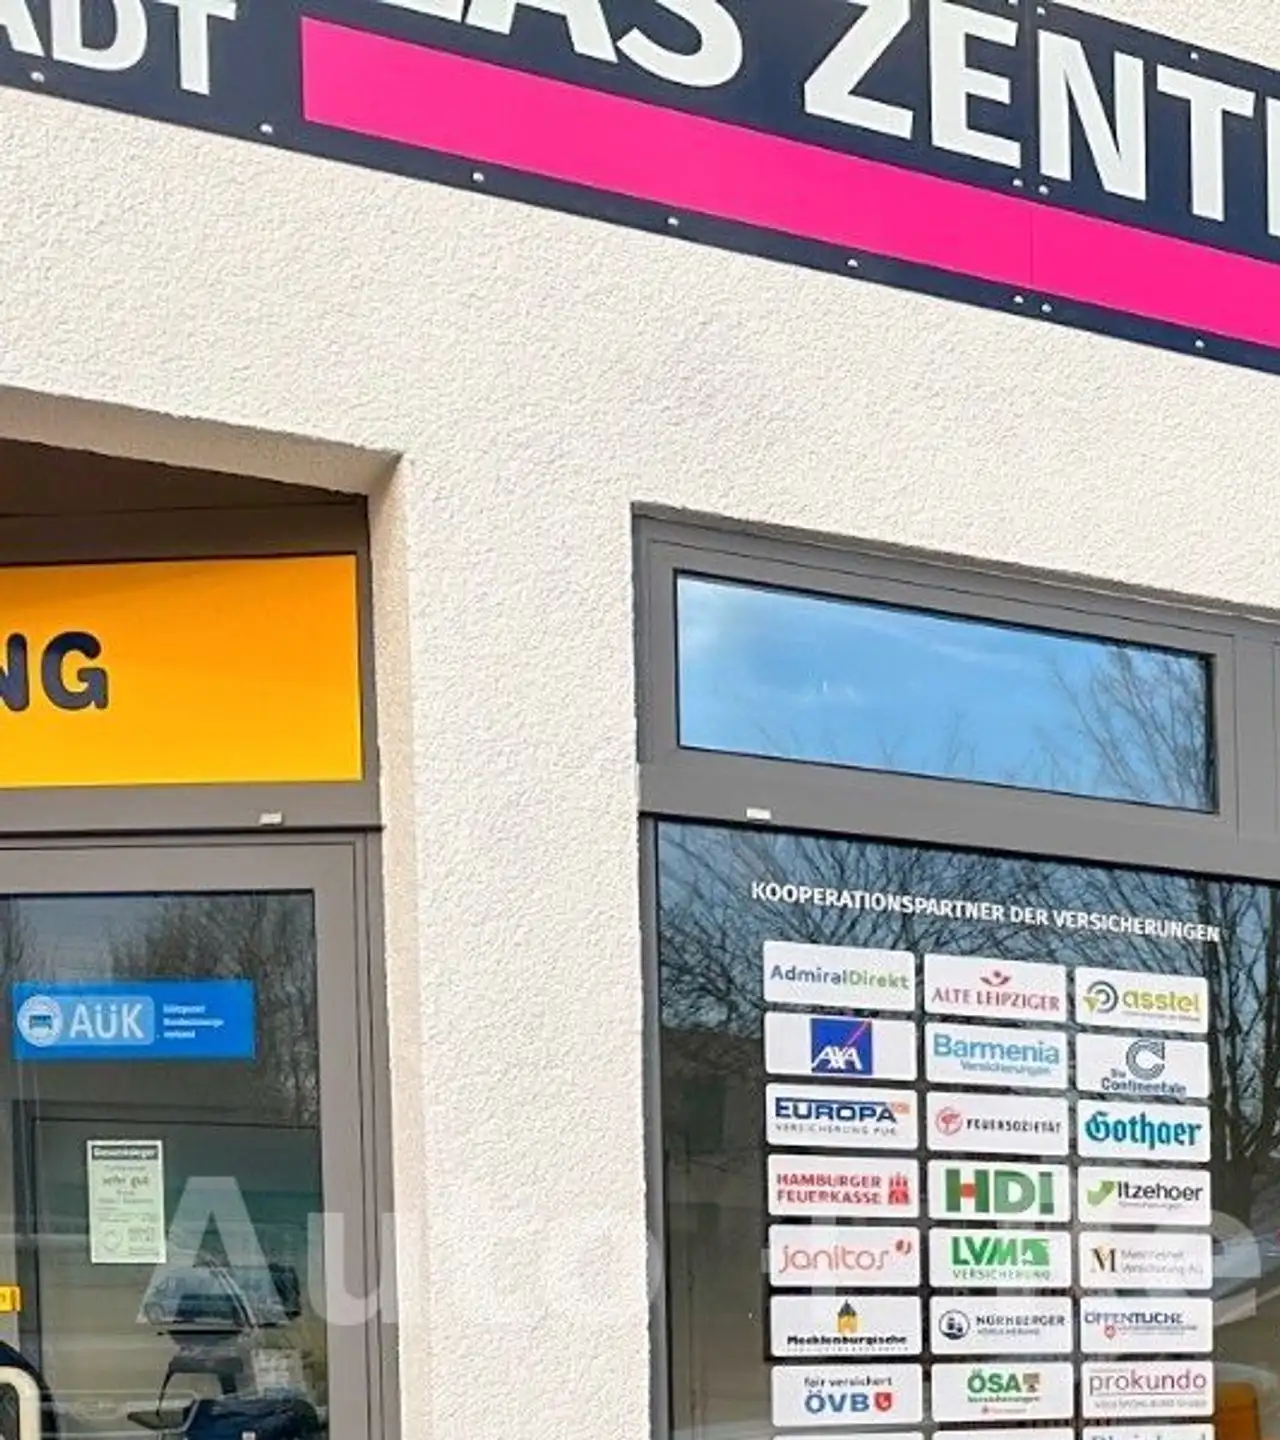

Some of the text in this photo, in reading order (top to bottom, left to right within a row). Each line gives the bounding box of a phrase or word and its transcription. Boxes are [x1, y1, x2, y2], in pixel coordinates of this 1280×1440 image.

[751, 881, 1220, 942] KOOPERATIONSPARTNER DER VERSICHERUNGEN
[770, 964, 910, 990] AdmiralDirekt
[931, 988, 1061, 1012] ALTE LEIPZIGER
[69, 1002, 146, 1040] AÜK
[811, 1046, 863, 1071] AXA
[933, 1033, 1060, 1065] Barmenia
[775, 1096, 897, 1123] EUROPA
[1083, 1110, 1203, 1152] Gothaer
[777, 1172, 883, 1189] HAMBURGER
[944, 1168, 1055, 1215] HDI
[1117, 1180, 1204, 1201] Itzehoer
[777, 1189, 883, 1205] FEUERKASSE
[778, 1243, 890, 1273] janitos
[951, 1236, 1018, 1266] LVM
[966, 1367, 1023, 1394] ÖSA
[1089, 1368, 1207, 1396] prokundo
[804, 1389, 870, 1414] ÖVB
